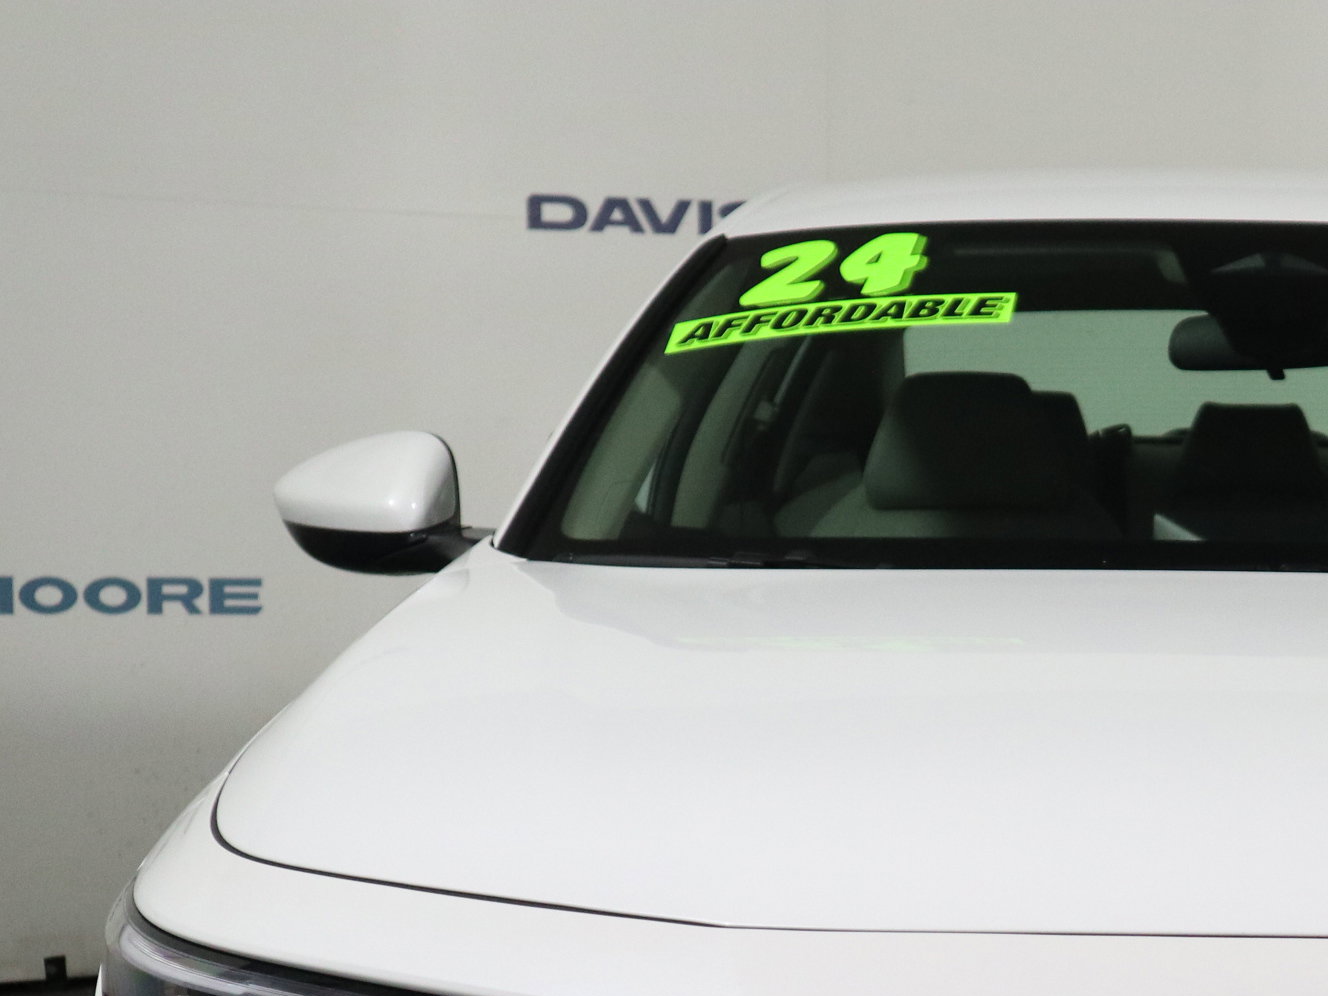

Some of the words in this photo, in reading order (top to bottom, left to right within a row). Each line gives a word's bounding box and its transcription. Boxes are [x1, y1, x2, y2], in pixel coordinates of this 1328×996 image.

[738, 232, 928, 307] 24
[677, 295, 1006, 348] AFFORDABLE
[0, 575, 263, 616] OORE
